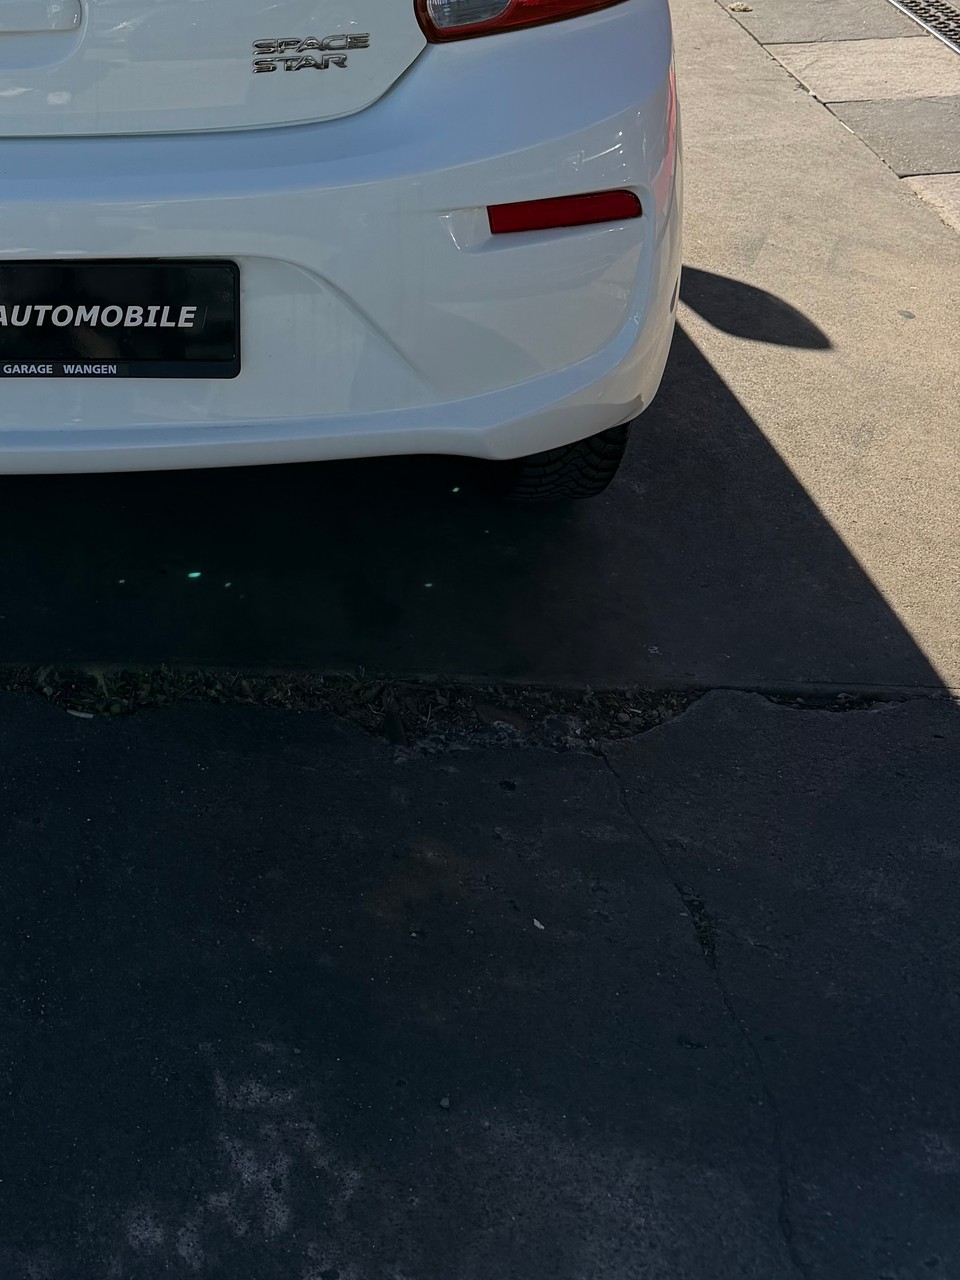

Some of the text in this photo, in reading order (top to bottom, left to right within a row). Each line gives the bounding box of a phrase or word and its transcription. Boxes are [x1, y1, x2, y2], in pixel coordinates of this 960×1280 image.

[252, 33, 370, 55] SPACE
[252, 53, 348, 73] STAR
[3, 364, 53, 375] GARAGE
[63, 364, 117, 375] WANGEN
